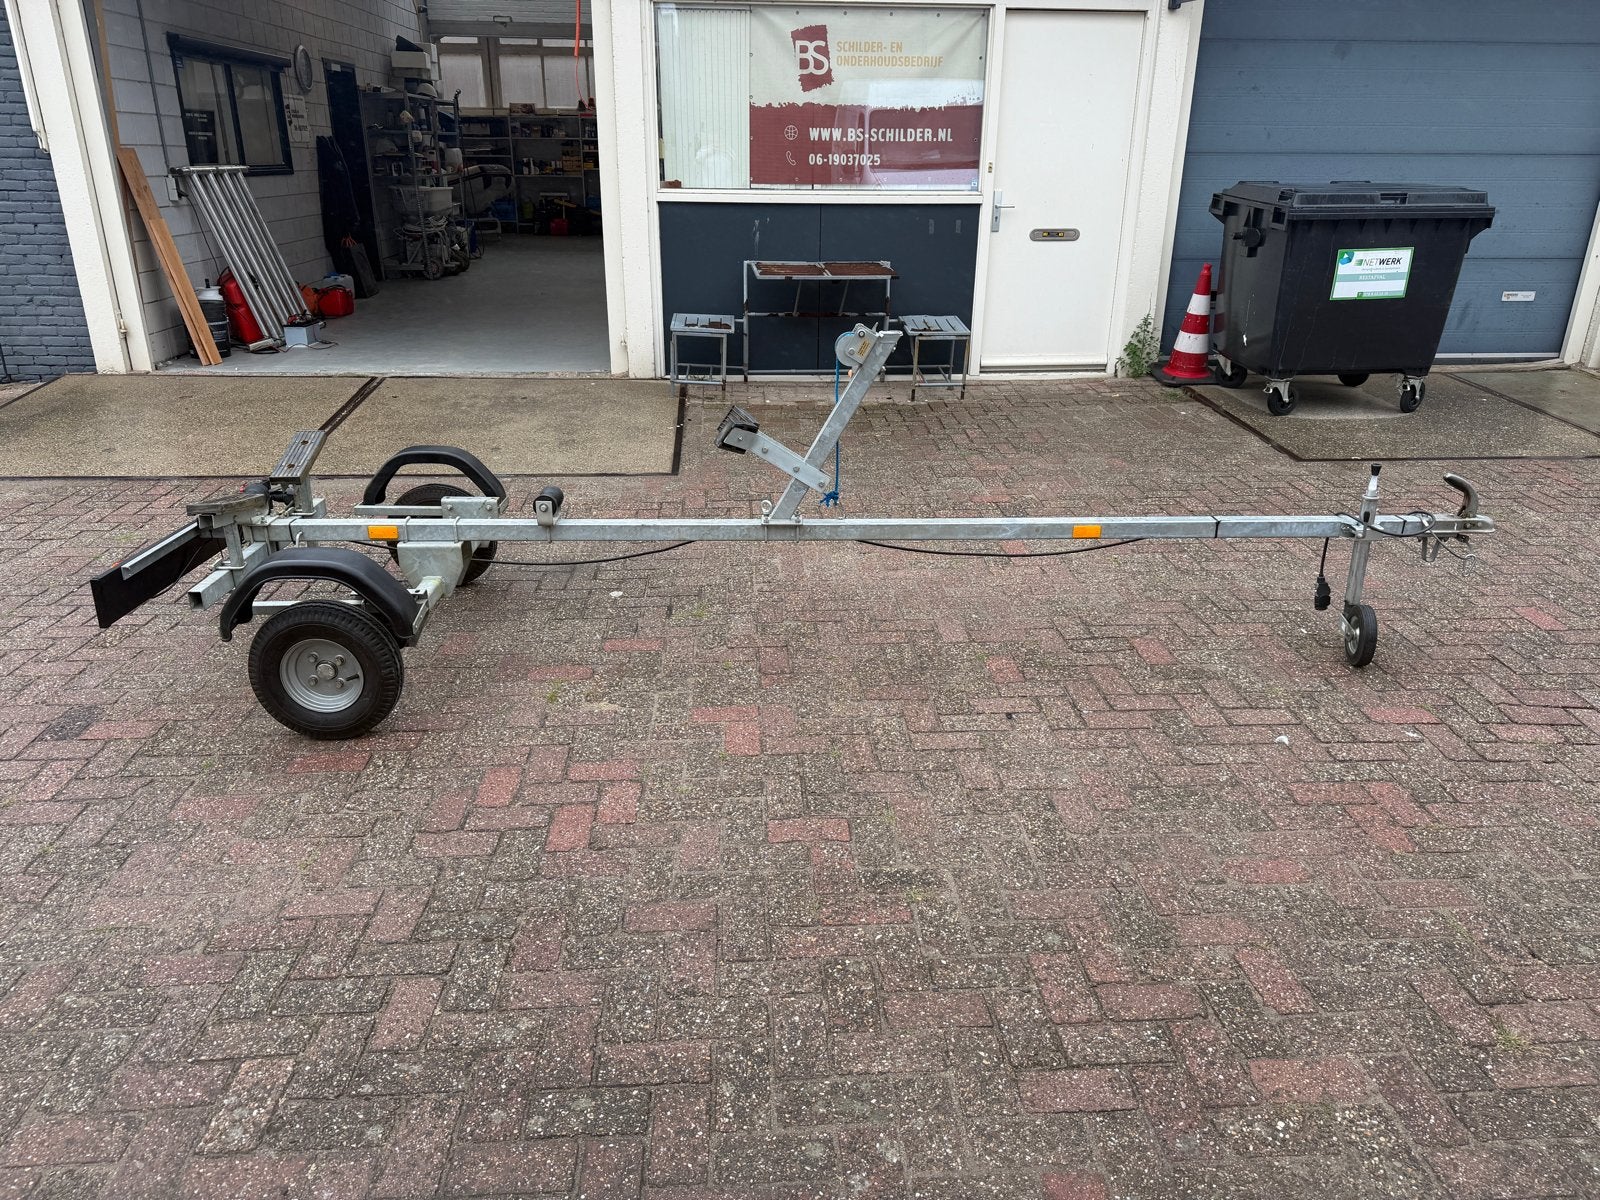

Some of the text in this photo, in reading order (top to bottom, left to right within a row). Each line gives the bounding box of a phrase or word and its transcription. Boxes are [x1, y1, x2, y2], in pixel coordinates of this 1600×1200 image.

[836, 41, 903, 53] SCHILDER- EN
[795, 40, 829, 75] BS
[836, 55, 944, 68] ONDERHOUDSBEDRIJF
[809, 127, 953, 142] WWW.BS-SCHILDER.NL
[808, 153, 881, 166] 06-19037025
[1362, 257, 1403, 266] NETWERK
